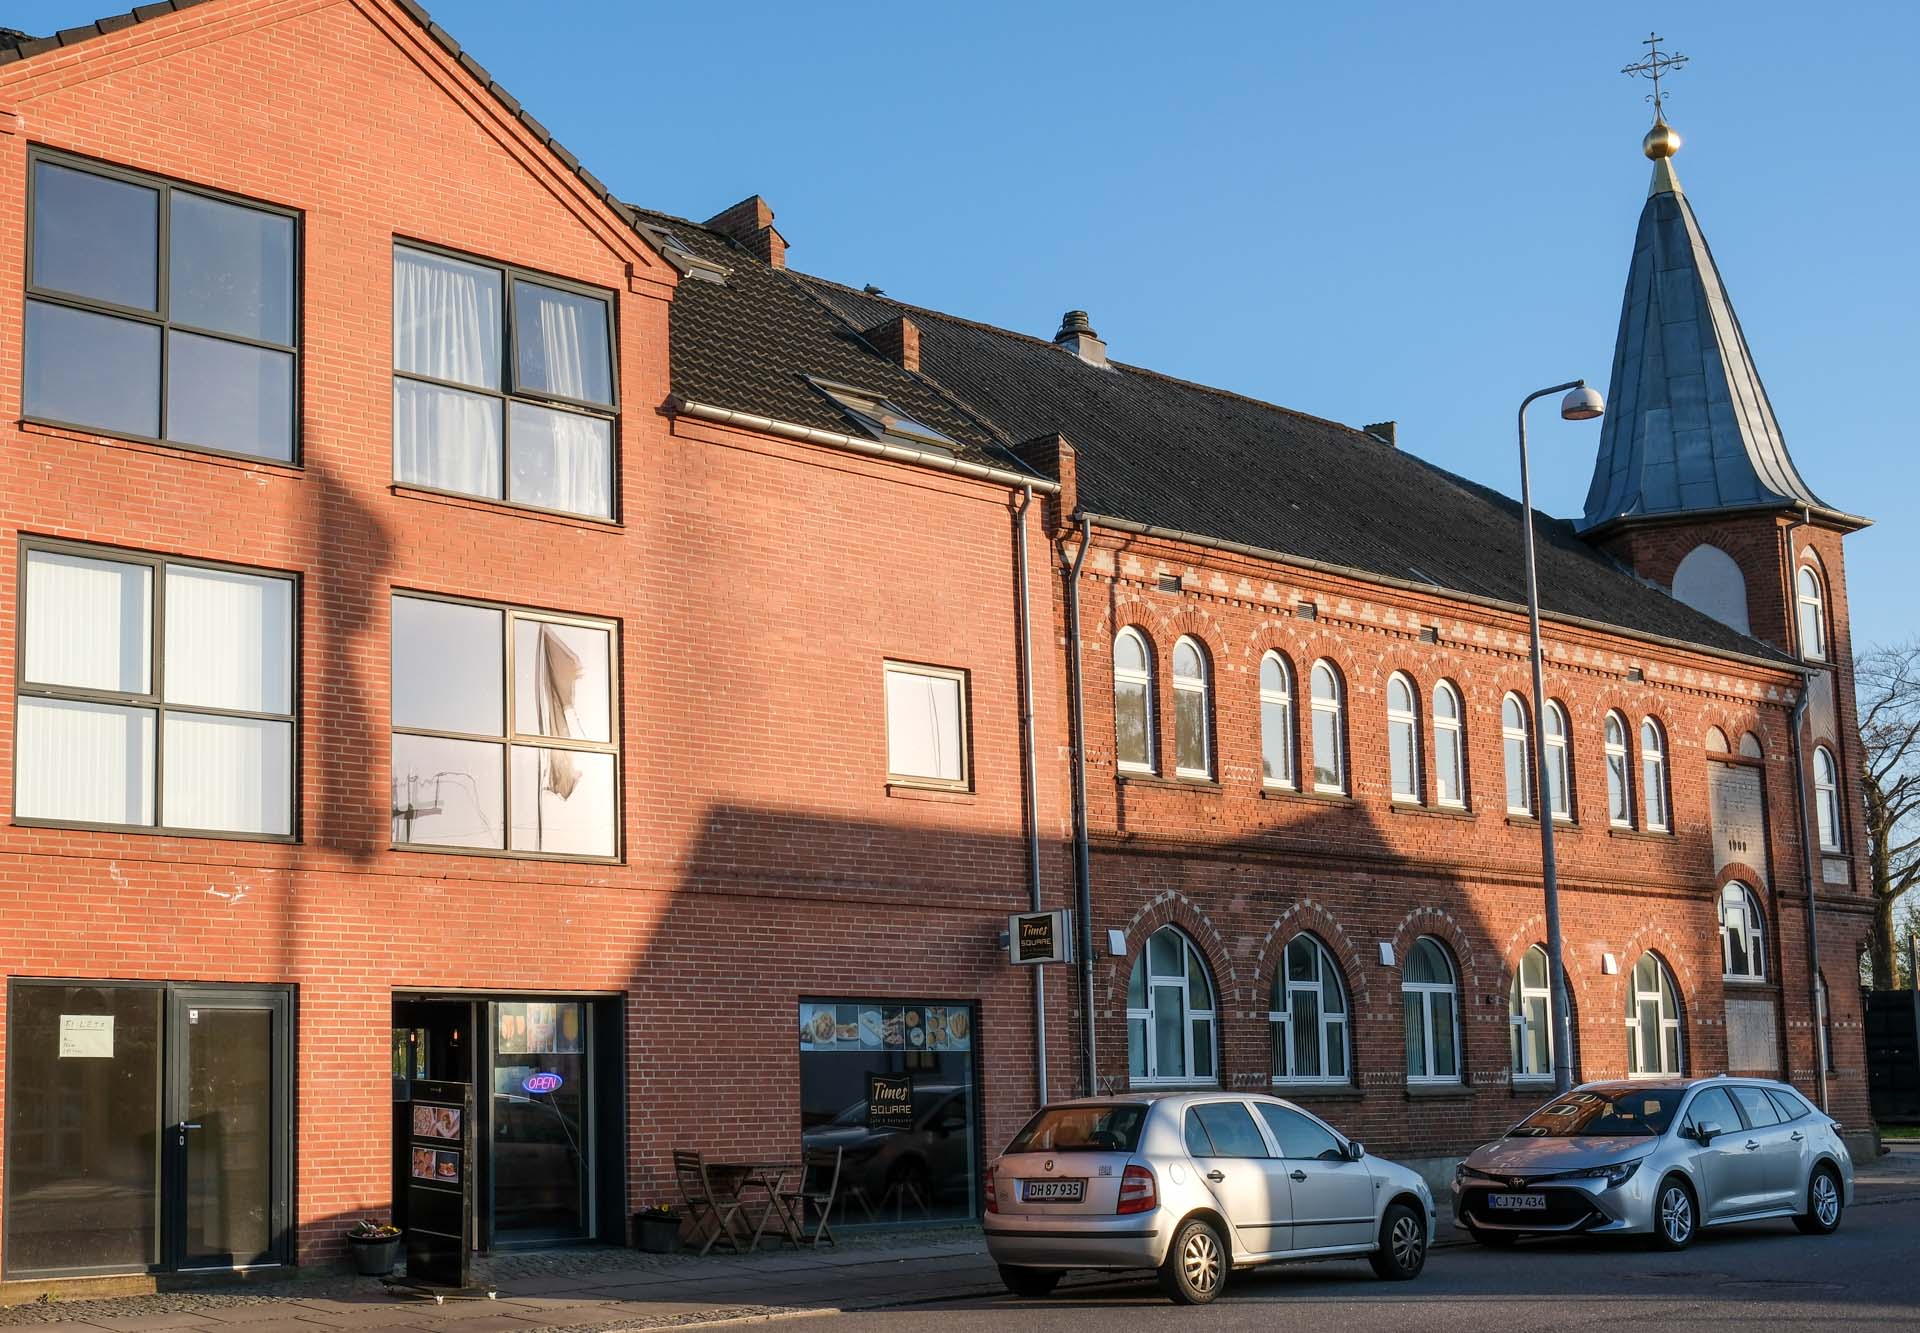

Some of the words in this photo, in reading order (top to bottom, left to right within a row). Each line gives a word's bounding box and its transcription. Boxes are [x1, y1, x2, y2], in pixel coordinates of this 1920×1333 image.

[1023, 924, 1048, 937] Times
[1021, 938, 1051, 947] SQUARE
[528, 1077, 557, 1089] OPEN
[874, 1082, 908, 1101] Times
[871, 1105, 912, 1114] SQUARE
[1030, 1184, 1044, 1196] DH
[1045, 1183, 1058, 1196] 87
[1060, 1183, 1079, 1195] 935
[1496, 1196, 1508, 1207] CJ
[1511, 1196, 1523, 1207] 79
[1525, 1196, 1544, 1207] 434
